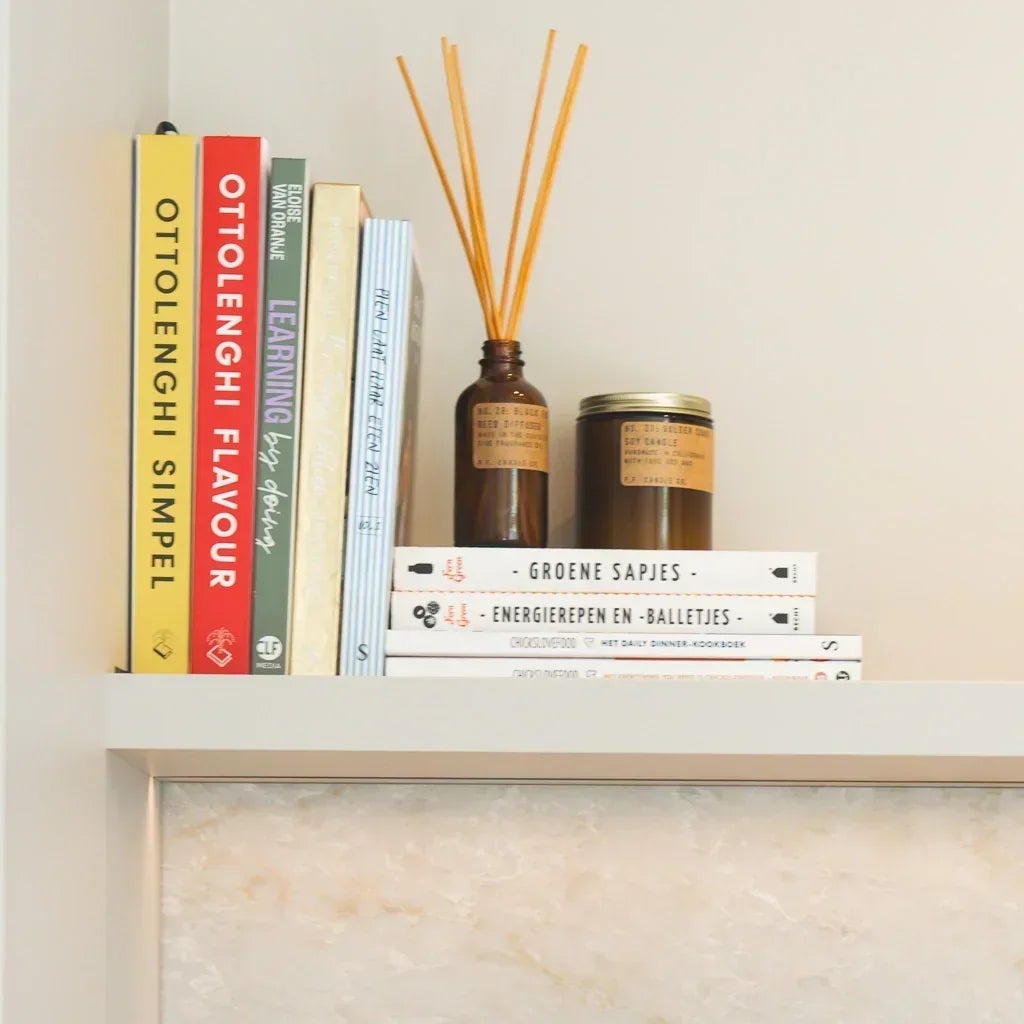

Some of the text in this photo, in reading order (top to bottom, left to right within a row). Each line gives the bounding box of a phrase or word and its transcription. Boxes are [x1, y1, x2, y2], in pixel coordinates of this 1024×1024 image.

[270, 184, 287, 261] VAN ORANJE
[286, 184, 303, 223] ELOISE
[151, 198, 179, 589] OTTOLENGHI SIMPEL
[209, 173, 246, 588] OTTOLENGHI FLAVOUR
[364, 287, 391, 496] PIEN LAAT HAAR ETEN ZIEN
[255, 299, 297, 555] LEARNING by doing
[529, 562, 681, 582] GROENE SAPJES
[493, 606, 606, 624] ENERGIEREPEN
[613, 607, 632, 625] EN
[357, 643, 369, 662] S
[821, 640, 839, 652] S
